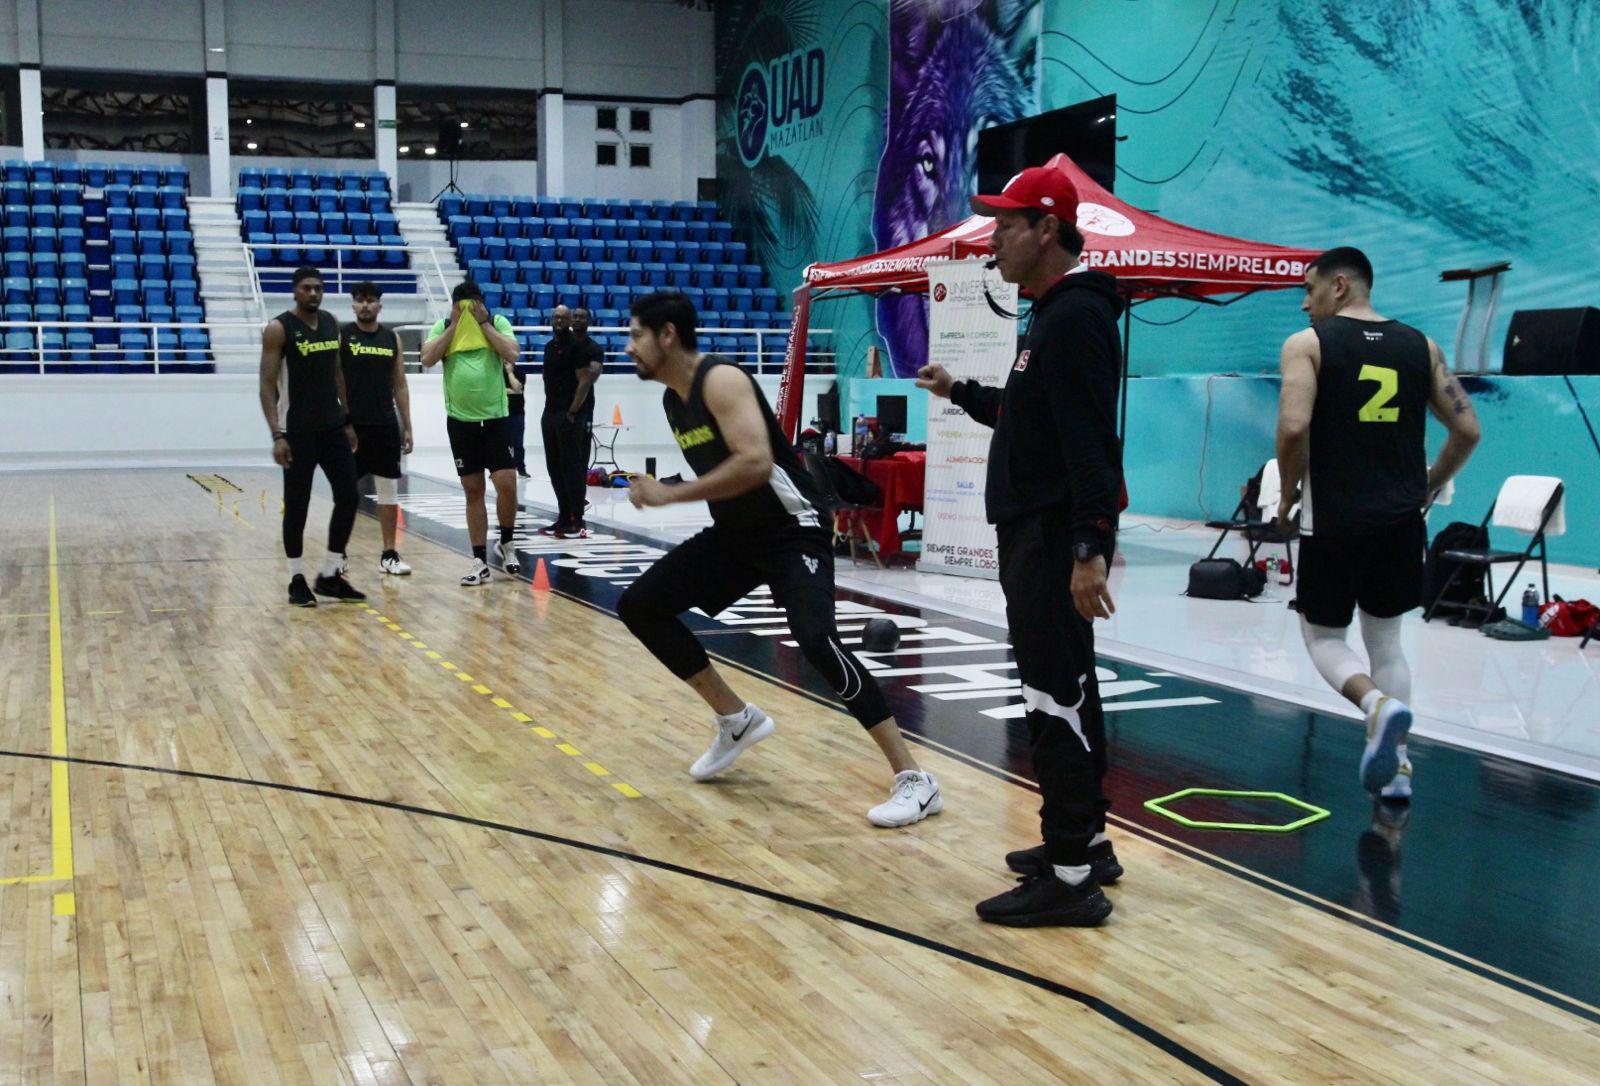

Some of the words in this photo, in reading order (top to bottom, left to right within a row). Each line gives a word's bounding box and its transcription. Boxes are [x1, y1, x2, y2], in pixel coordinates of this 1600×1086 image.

[771, 48, 825, 128] UAD
[1358, 364, 1400, 422] 2
[926, 543, 955, 555] SIEMPRE
[957, 546, 993, 558] GRANDES
[944, 555, 972, 567] SIEMPRE
